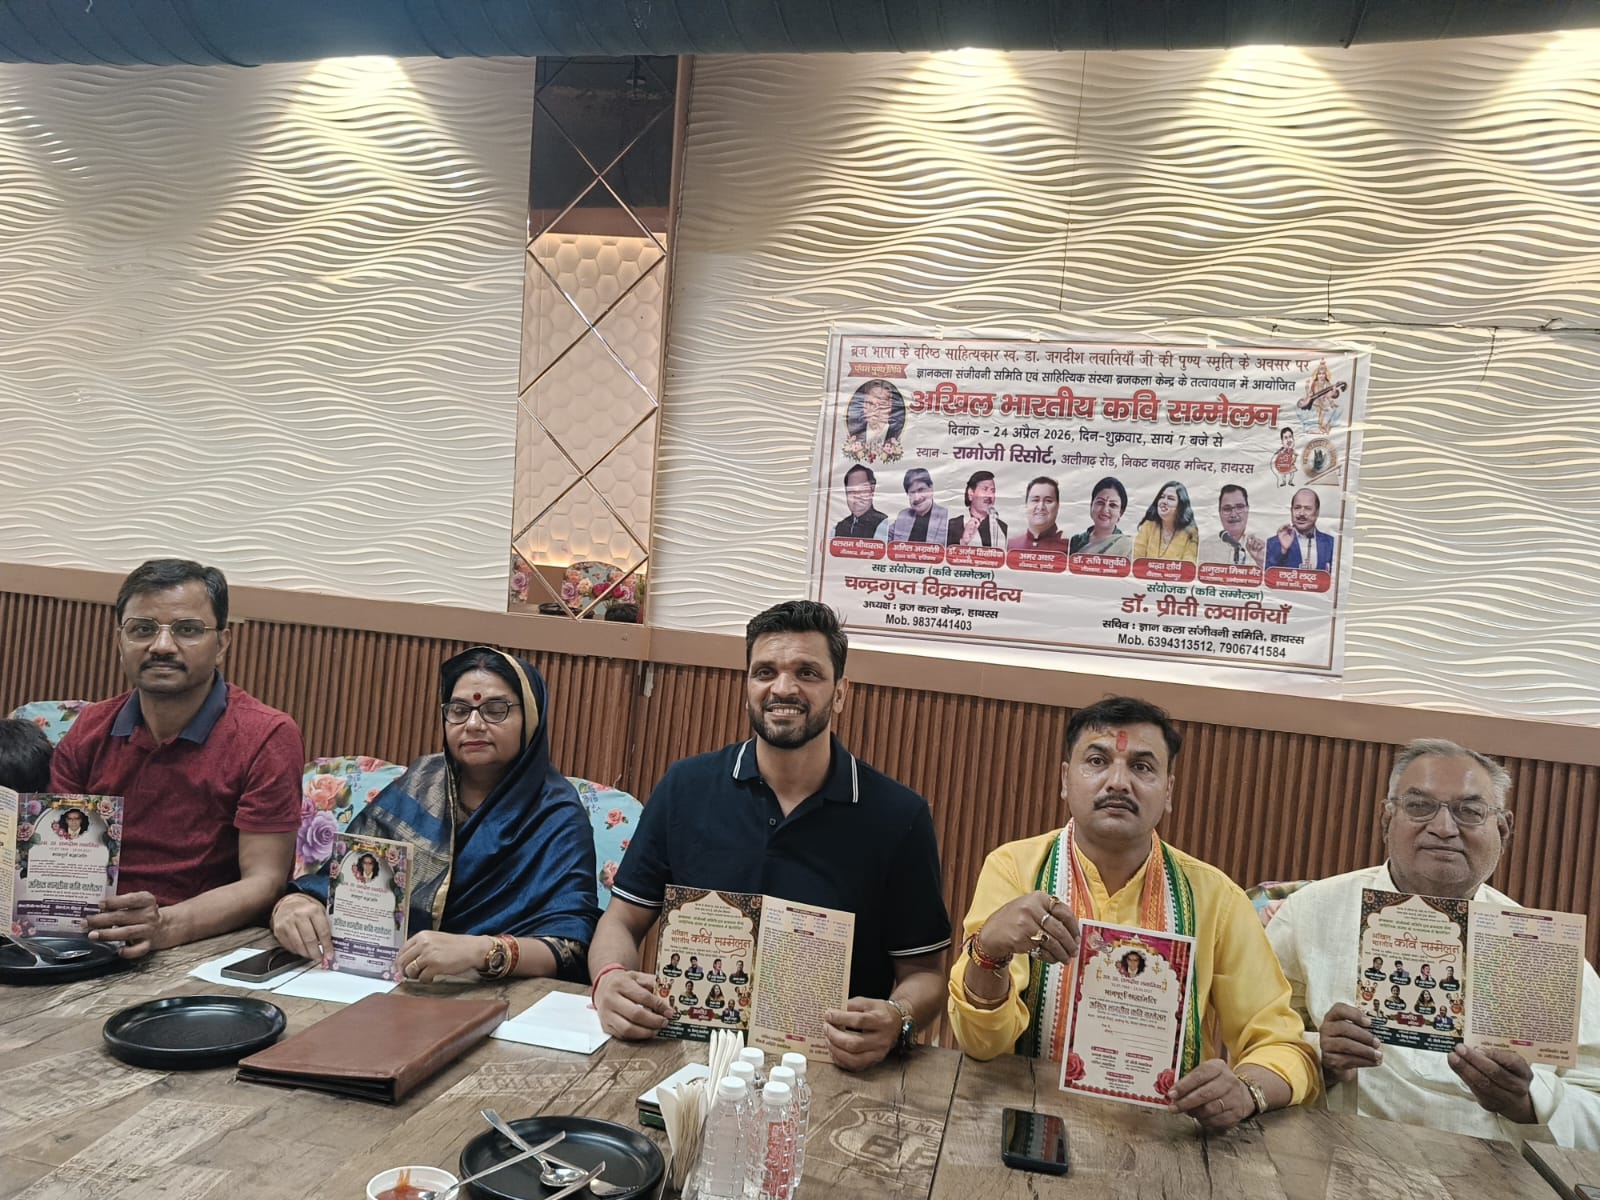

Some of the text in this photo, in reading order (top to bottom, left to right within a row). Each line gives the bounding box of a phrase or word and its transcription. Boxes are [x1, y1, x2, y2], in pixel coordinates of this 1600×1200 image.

[871, 345, 895, 358] भाषा
[899, 343, 910, 358] के
[914, 343, 941, 360] वरिष्ठ
[945, 345, 999, 362] साहित्यकार
[1003, 350, 1019, 363] स्व.
[1024, 348, 1040, 362] डा.
[1045, 349, 1085, 365] जगदीश
[1139, 351, 1154, 368] जी
[1158, 352, 1174, 368] की
[1179, 354, 1201, 372] पुण्य
[1206, 353, 1234, 372] स्मृति
[1239, 353, 1251, 371] के
[1255, 358, 1293, 372] अवसर
[1296, 359, 1310, 373] पर
[916, 368, 953, 379] ज्ञानकला
[956, 367, 991, 381] संजीवनी
[994, 367, 1023, 381] समिति
[1025, 368, 1039, 382] एवं
[1042, 369, 1085, 384] साहित्यिक
[1088, 372, 1114, 385] संस्था
[1116, 374, 1152, 387] ब्रजकला
[1155, 374, 1175, 388] केन्द्र
[1178, 374, 1188, 386] के
[1239, 375, 1250, 390] में
[1252, 377, 1296, 392] आयोजित
[909, 382, 1281, 428] अखिल भारतीय कवि सम्मेलन
[948, 424, 980, 437] दिनांक
[994, 426, 1009, 438] 24
[1013, 424, 1041, 439] अप्रैल
[1044, 428, 1075, 443] 2026,
[1151, 431, 1174, 445] सायं
[1178, 434, 1186, 446] 7
[1190, 433, 1209, 448] बजे
[1213, 435, 1225, 448] से
[916, 446, 939, 458] स्थान
[953, 443, 1007, 461] रामोजी
[1010, 444, 1057, 466] रिसोर्ट,
[1099, 453, 1118, 469] रोड,
[1121, 454, 1149, 468] निकट
[1151, 458, 1181, 472] नवग्रह
[1184, 457, 1217, 474] मन्दिर,
[872, 563, 995, 581] सह संयोजक (कवि सम्मेलन)
[845, 575, 1023, 604] चन्द्रगुप्त विक्रमादित्य
[1147, 582, 1264, 601] संयोजक (कवि सम्मेलन)
[863, 600, 891, 611] अध्यक्ष
[899, 603, 915, 613] ब्रज
[917, 604, 938, 615] कला
[1120, 593, 1149, 615] डॉ.
[1156, 594, 1199, 618] प्रीती
[885, 613, 973, 631] Mob. 9837441403
[1103, 619, 1131, 631] सचिव
[1139, 622, 1160, 633] ज्ञान
[1162, 624, 1185, 635] कला
[1188, 625, 1229, 639] संजीवनी
[1118, 633, 1286, 659] Mob. 6394313512, 7906741584
[691, 927, 712, 945] कवि
[1394, 932, 1417, 950] कवि
